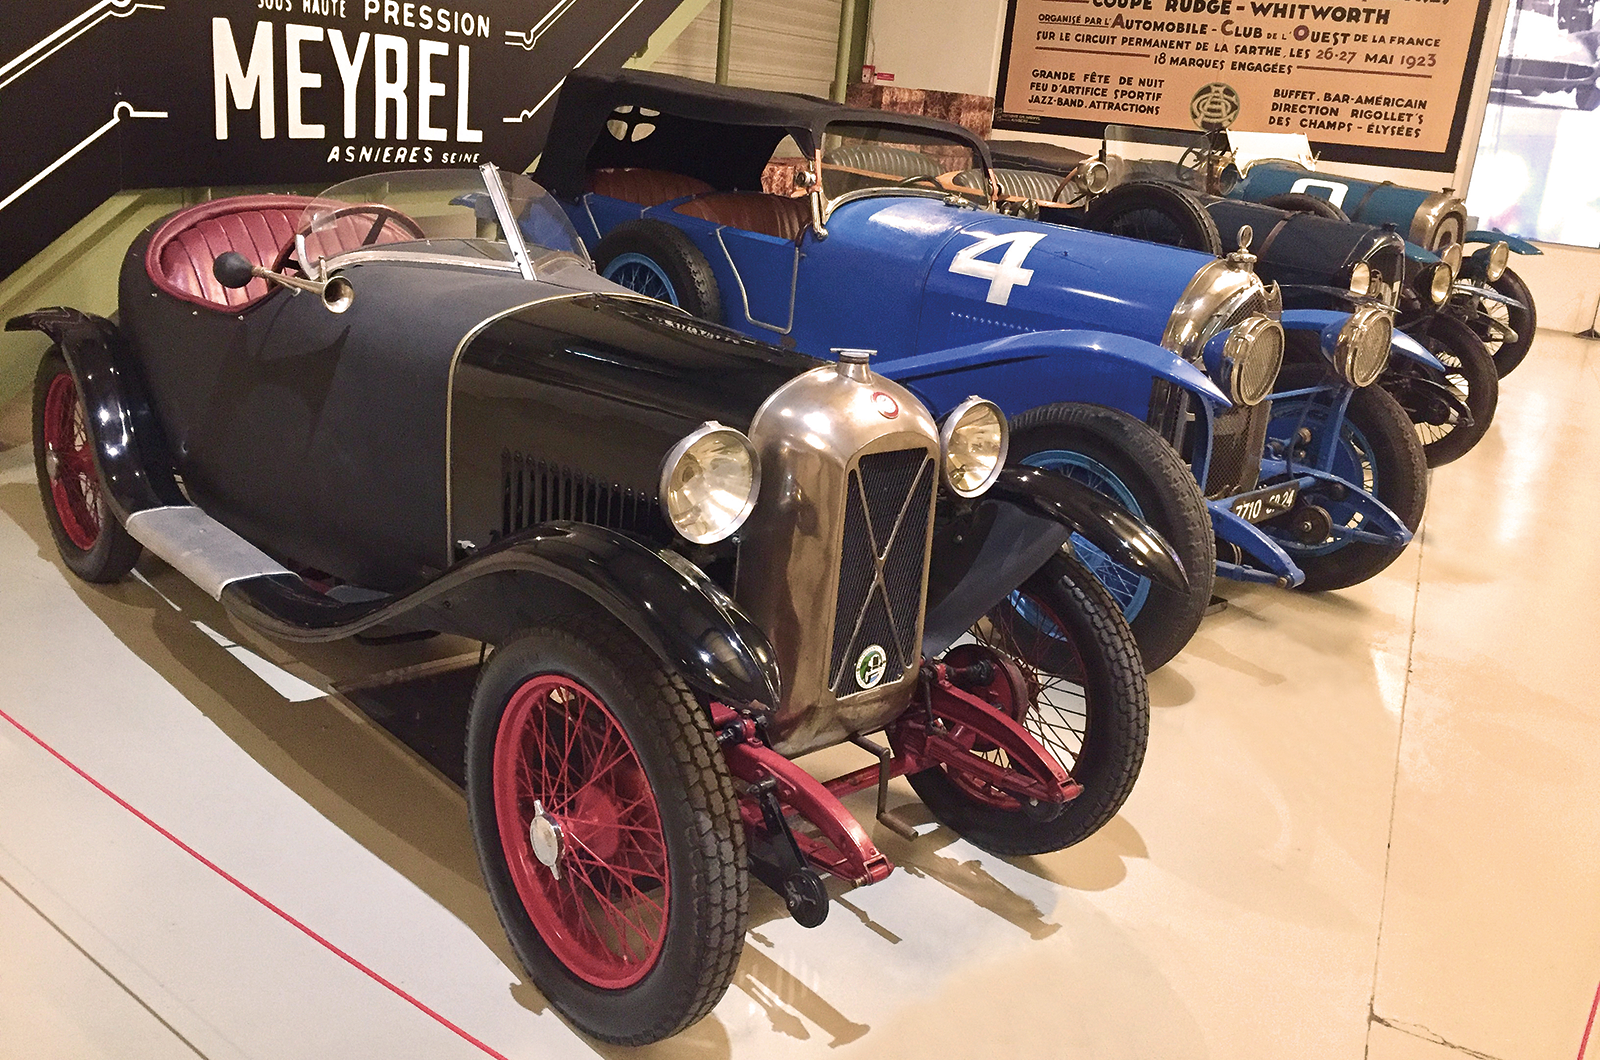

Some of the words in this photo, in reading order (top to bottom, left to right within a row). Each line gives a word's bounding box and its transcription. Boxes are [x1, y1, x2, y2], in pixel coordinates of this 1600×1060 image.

[302, 0, 346, 18] HAUTE
[364, 0, 490, 39] PRESSION
[1092, 0, 1153, 10] COUPE
[1165, 0, 1232, 14] RUDGE
[1250, 1, 1391, 25] WHITWORTH
[1038, 14, 1082, 24] ORGANISÉ
[1085, 16, 1102, 25] PAR
[1220, 19, 1263, 38] CLUB
[1266, 32, 1278, 40] DE
[1354, 34, 1368, 43] DE
[1372, 35, 1386, 44] LA
[1389, 36, 1441, 47] FRANCE
[1036, 31, 1055, 41] SUR
[1060, 33, 1071, 42] LE
[1075, 33, 1117, 45] CIRCUIT
[1121, 36, 1191, 50] PERMANENT
[1195, 42, 1209, 51] DE
[1214, 43, 1228, 53] LA
[1289, 48, 1311, 59] LES
[1364, 53, 1394, 65] MAI
[1400, 53, 1437, 70] 1923
[1154, 52, 1167, 65] 18
[1169, 55, 1226, 70] MARQUES
[1230, 60, 1293, 75] ENGAGÉES
[212, 17, 483, 143] MEYREL
[1031, 69, 1075, 82] GRANDE
[1083, 71, 1110, 84] FÊTE
[1119, 76, 1133, 86] DE
[1138, 77, 1165, 88] NUIT
[1030, 82, 1049, 92] FEU
[1051, 83, 1108, 97] D'ARTIFICE
[1114, 89, 1162, 101] SPORTIF
[1323, 92, 1428, 110] BAR-AMÉRICAIN
[1088, 101, 1161, 115] ATTRACTIONS
[1271, 102, 1340, 117] DIRECTION
[1350, 108, 1424, 125] RIGOLLET'S
[1268, 115, 1290, 127] DES
[1299, 118, 1353, 133] CHAMPS
[1366, 123, 1422, 138] ÉLYSÉES
[327, 146, 433, 163] ASNIERES
[441, 152, 480, 164] SEINE
[949, 230, 1048, 306] 4
